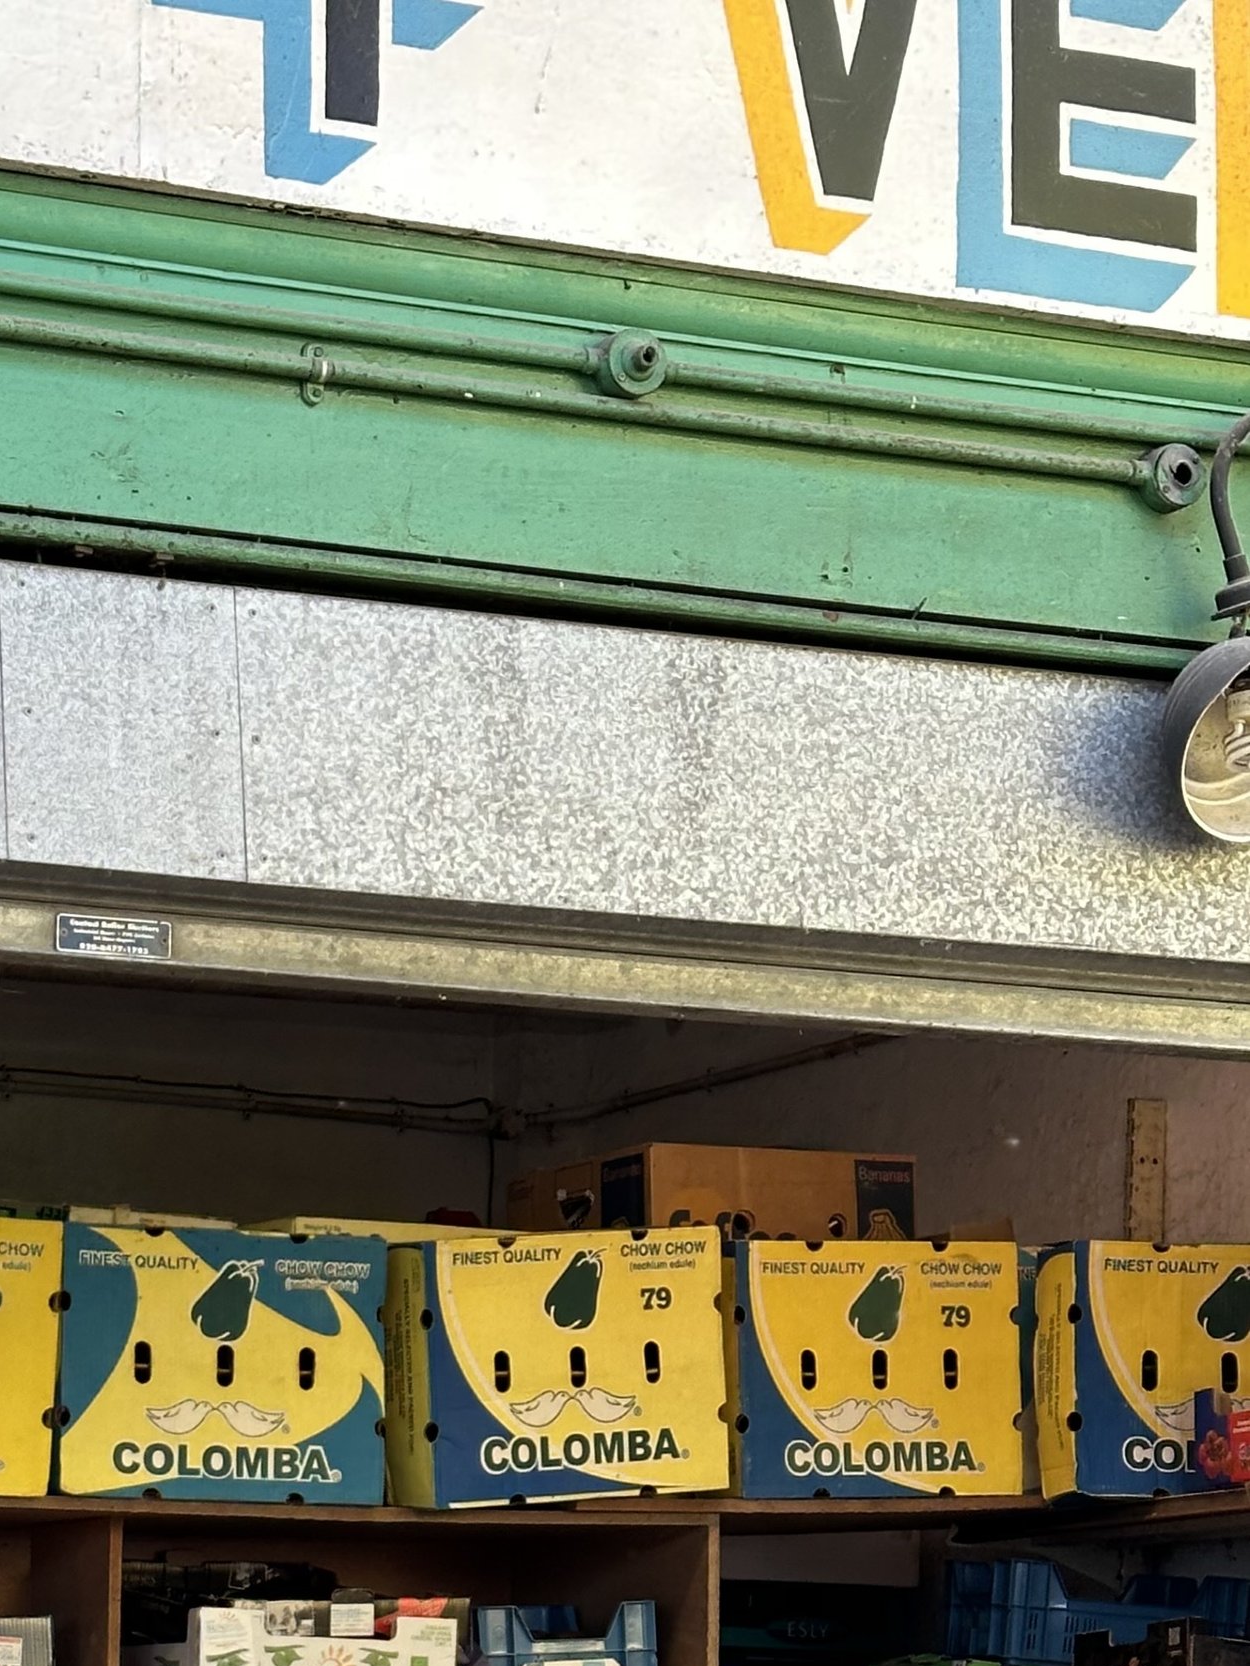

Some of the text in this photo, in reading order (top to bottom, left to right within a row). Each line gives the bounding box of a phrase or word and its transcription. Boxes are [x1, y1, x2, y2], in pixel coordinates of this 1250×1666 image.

[857, 1165, 911, 1184] Bananas
[79, 1250, 371, 1279] FINEST QUALITY CHOW CHOW
[452, 1240, 707, 1266] FINEST QUALITY CHOW CHOW
[762, 1260, 808, 1275] FINEST
[810, 1261, 866, 1275] QUALITY
[920, 1262, 960, 1276] CHOW
[962, 1262, 1003, 1277] CHOW
[1104, 1258, 1219, 1275] FINEST QUALITY
[640, 1286, 672, 1310] 79
[940, 1304, 972, 1329] 79
[112, 1440, 333, 1482] COLOMBA
[481, 1427, 681, 1475] COLOMBA
[784, 1440, 980, 1475] COLOMBA
